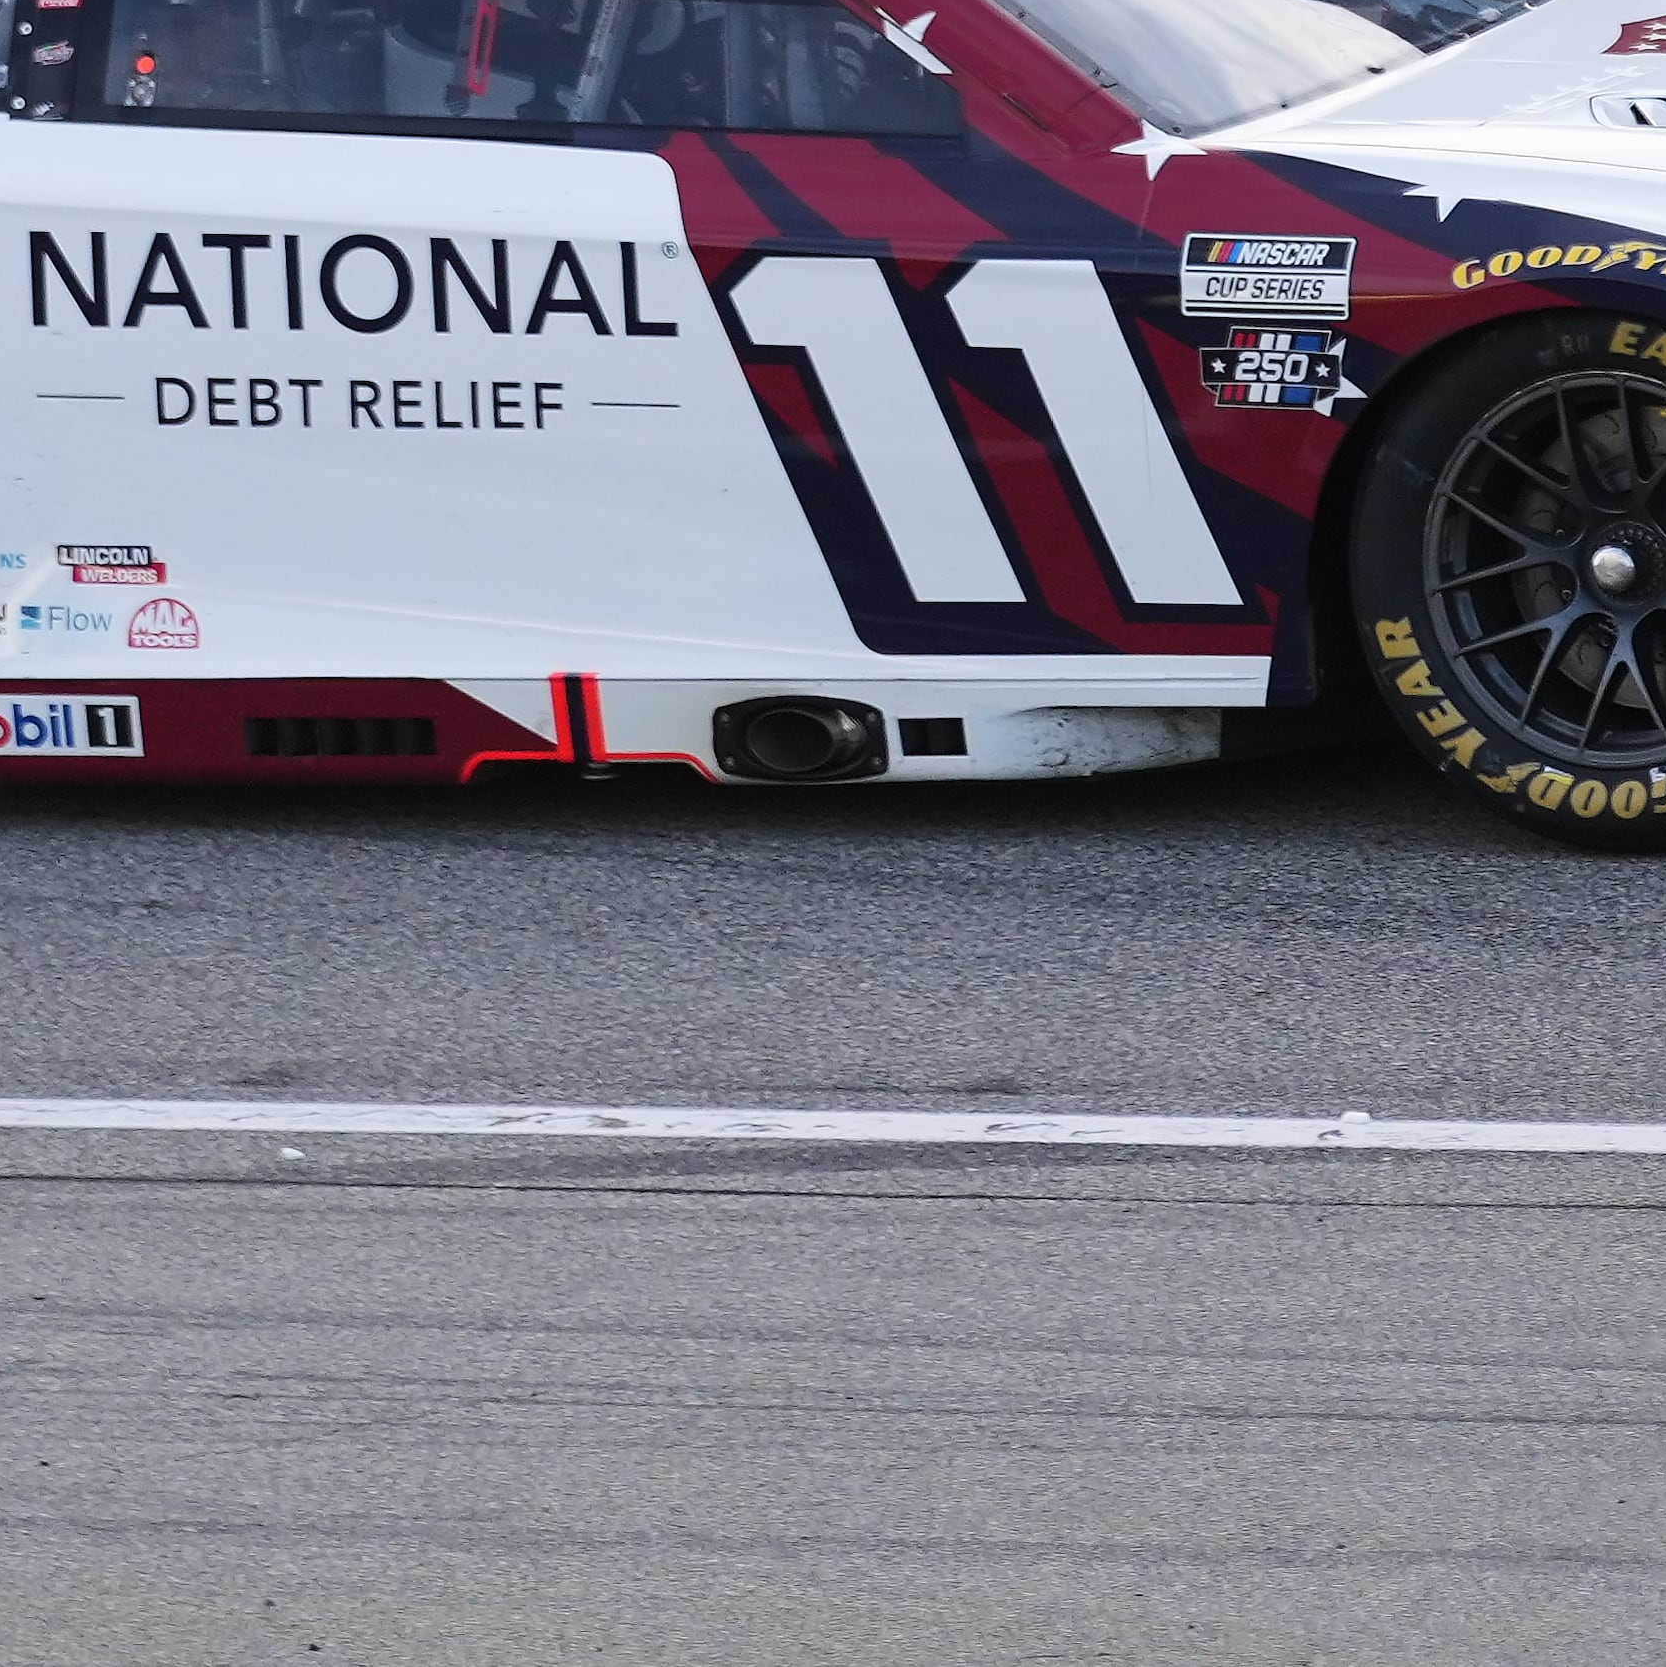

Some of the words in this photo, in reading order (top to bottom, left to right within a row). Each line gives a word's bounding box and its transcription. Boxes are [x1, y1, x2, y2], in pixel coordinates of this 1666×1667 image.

[1235, 241, 1331, 267] NASCAR
[27, 229, 681, 337] NATIONAL
[1205, 276, 1248, 299] CUP
[1250, 277, 1326, 301] SERIES
[1234, 350, 1310, 383] 250
[154, 376, 324, 429] DEBT
[349, 379, 564, 432] RELIEF
[729, 256, 1245, 606] 11
[58, 546, 151, 566] LINCOLN
[79, 566, 160, 583] WELDERS
[48, 605, 113, 632] Flow
[135, 598, 197, 634] MAC
[131, 633, 199, 649] TOOLS
